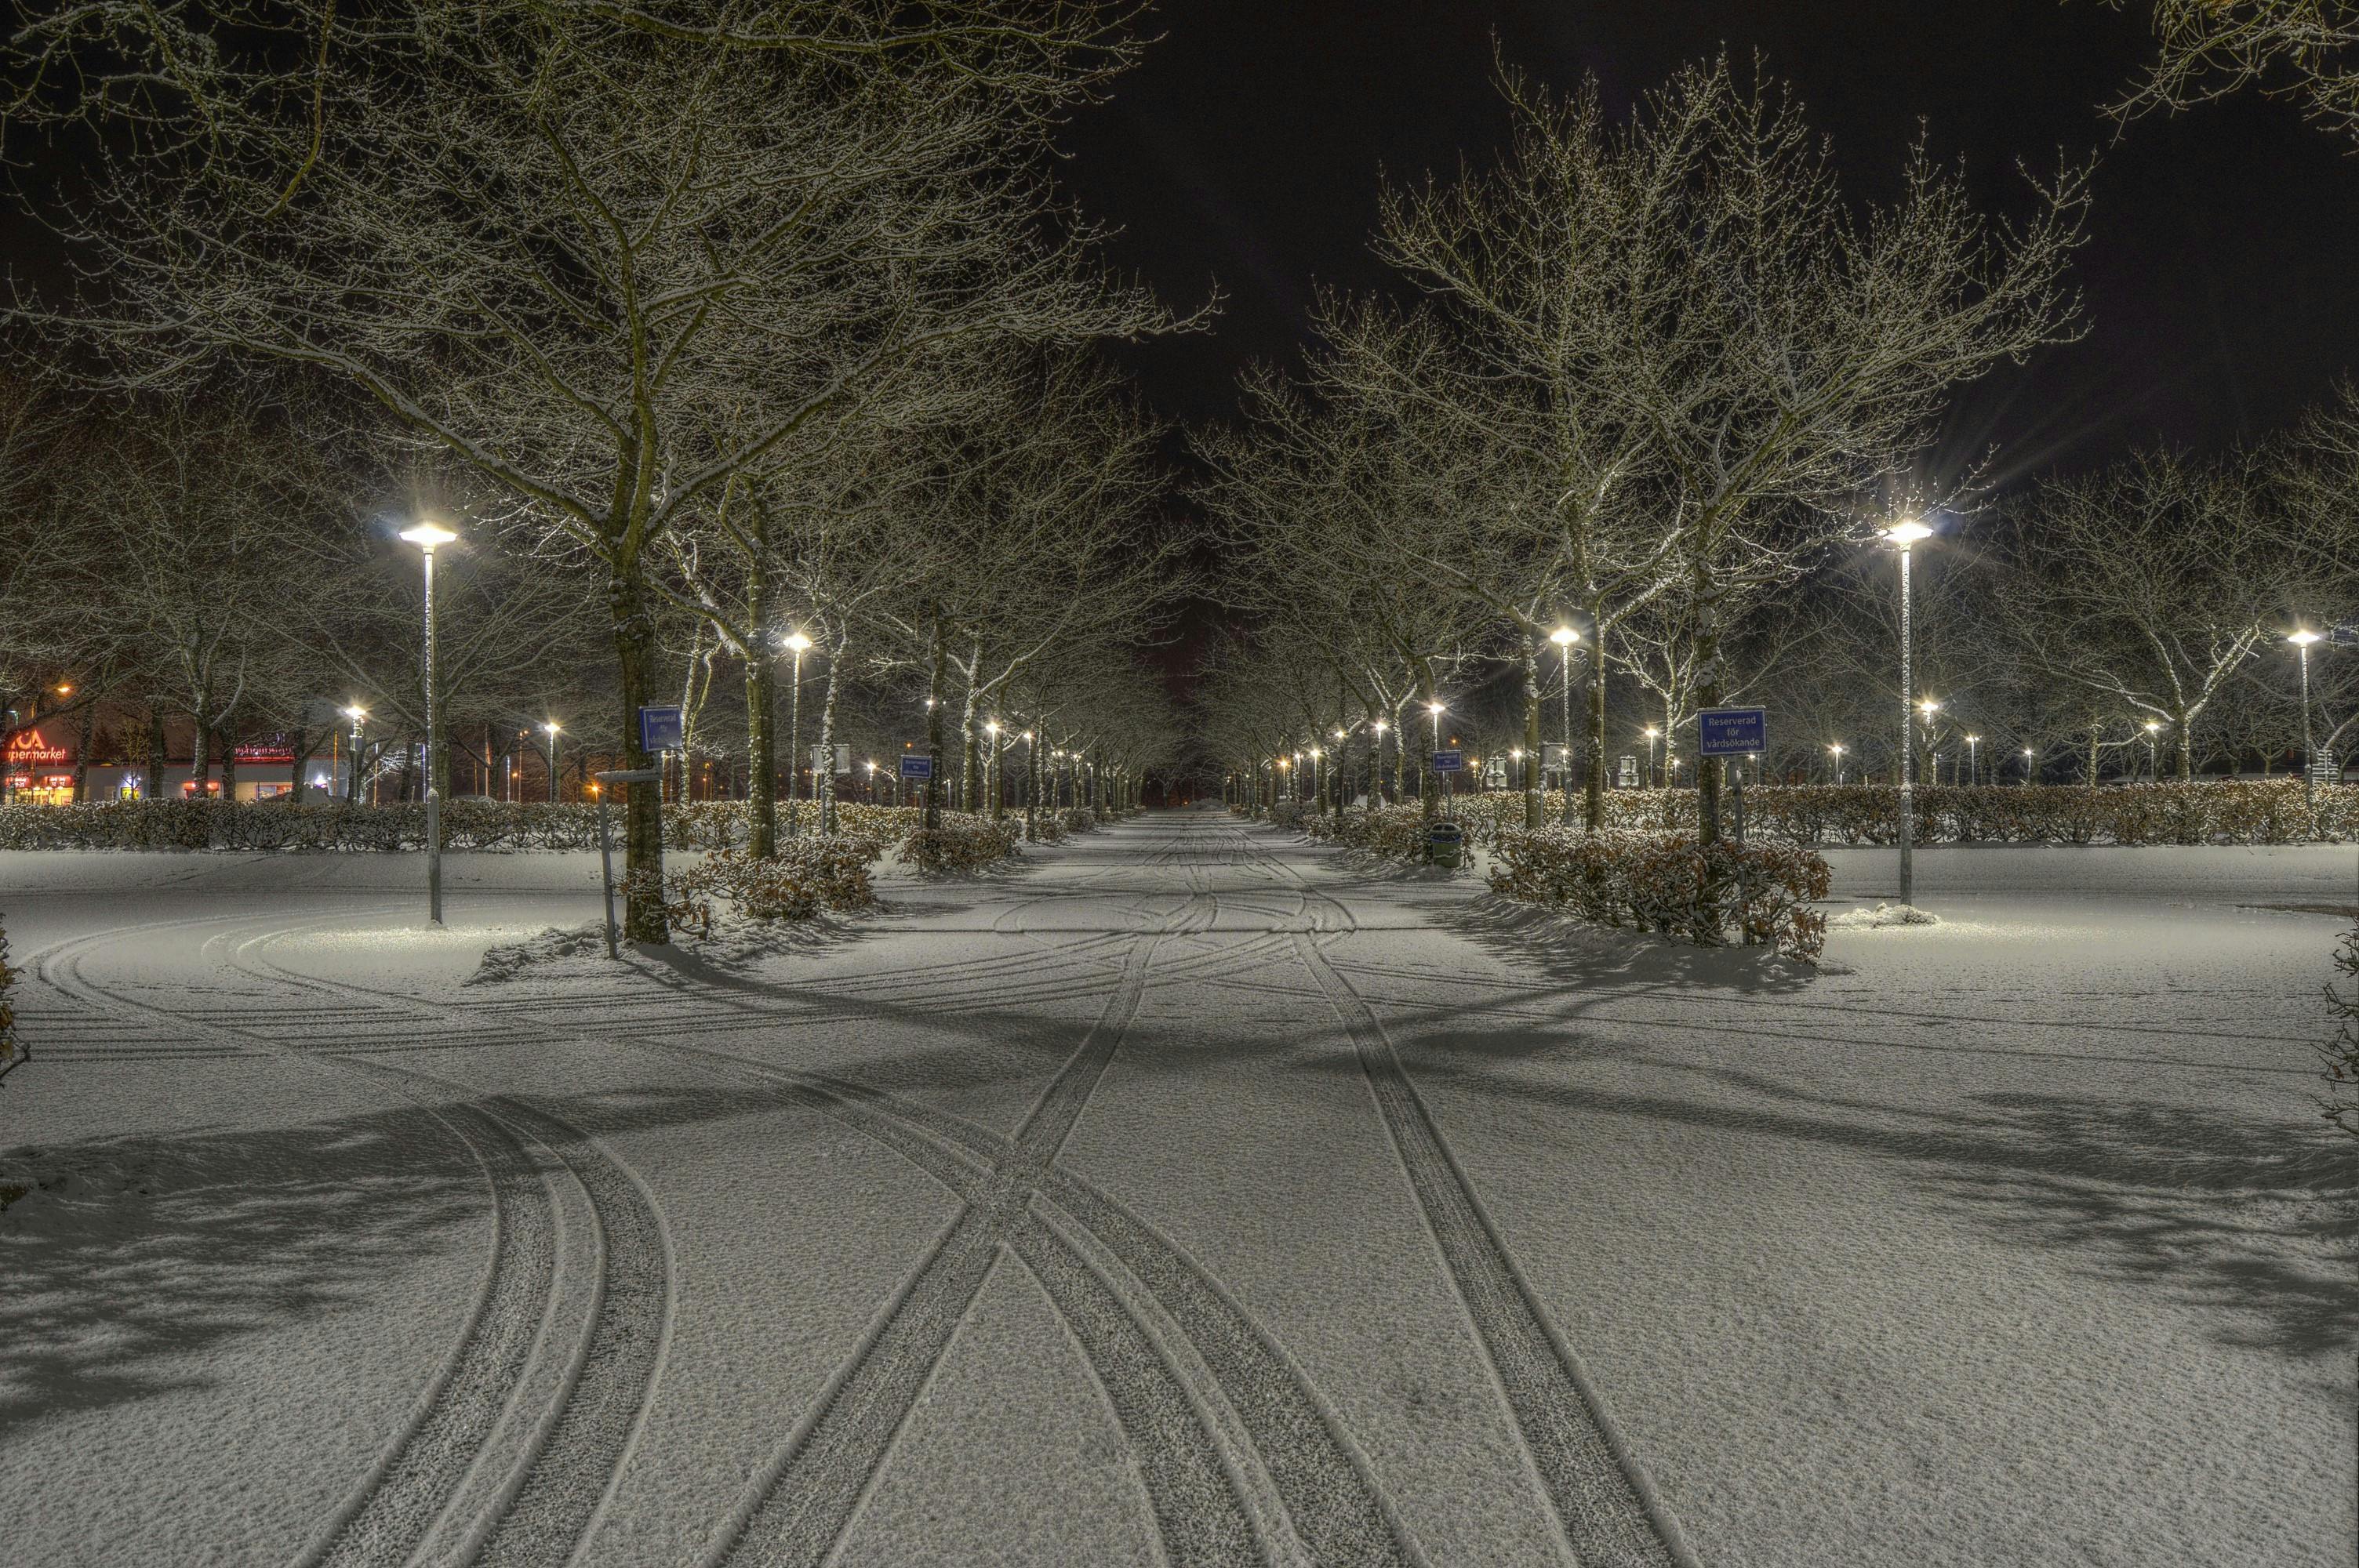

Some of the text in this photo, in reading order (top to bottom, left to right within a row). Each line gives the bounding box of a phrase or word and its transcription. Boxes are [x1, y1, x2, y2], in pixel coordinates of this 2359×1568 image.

[1708, 716, 1757, 727] Reserverad
[1726, 728, 1740, 737] för
[1707, 737, 1761, 749] vårdsökande
